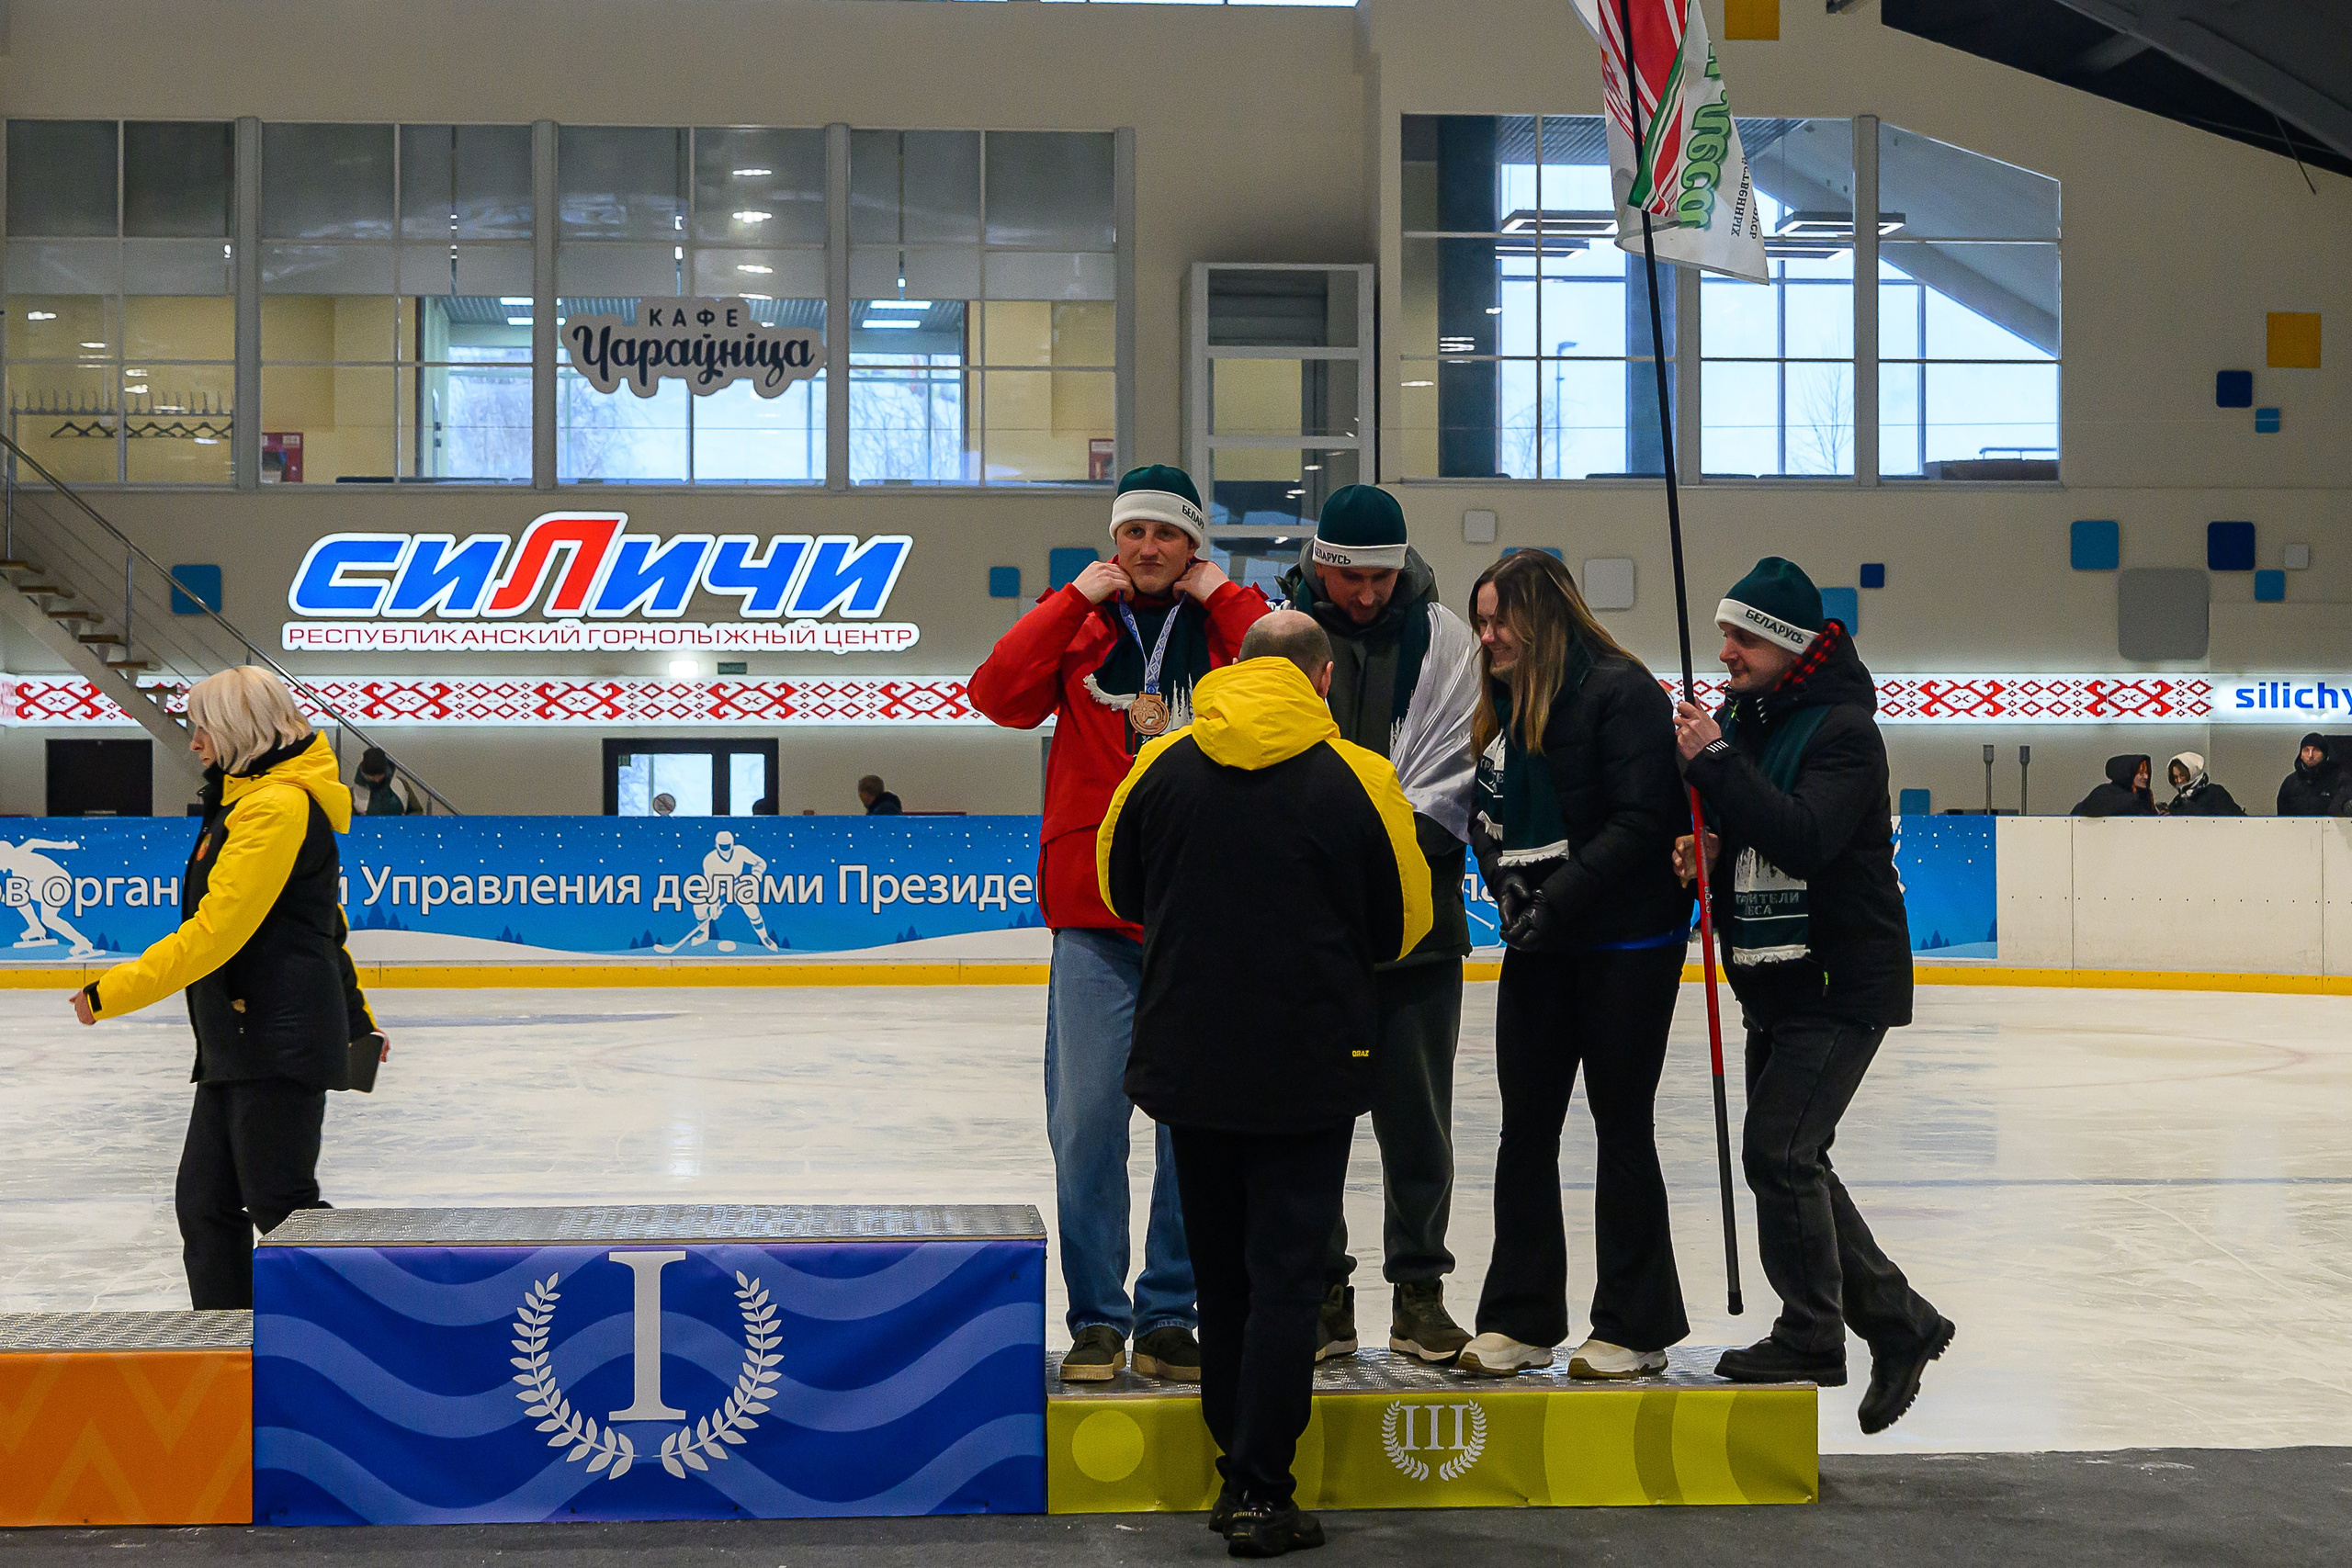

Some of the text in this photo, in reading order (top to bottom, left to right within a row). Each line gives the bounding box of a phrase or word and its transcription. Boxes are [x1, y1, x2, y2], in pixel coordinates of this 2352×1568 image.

[649, 308, 739, 328] КАФЕ
[572, 325, 816, 388] Чараўніца
[289, 626, 912, 652] РЕСПУБЛИКАНСКИЙ ГОРНОЛЫЖНЫЙ ЦЕНТР
[1746, 609, 1804, 644] БЕЛАРУСЬ
[360, 865, 641, 916] Управления
[651, 874, 825, 913] делами
[838, 864, 1039, 914] Президе
[1399, 1404, 1469, 1450] III
